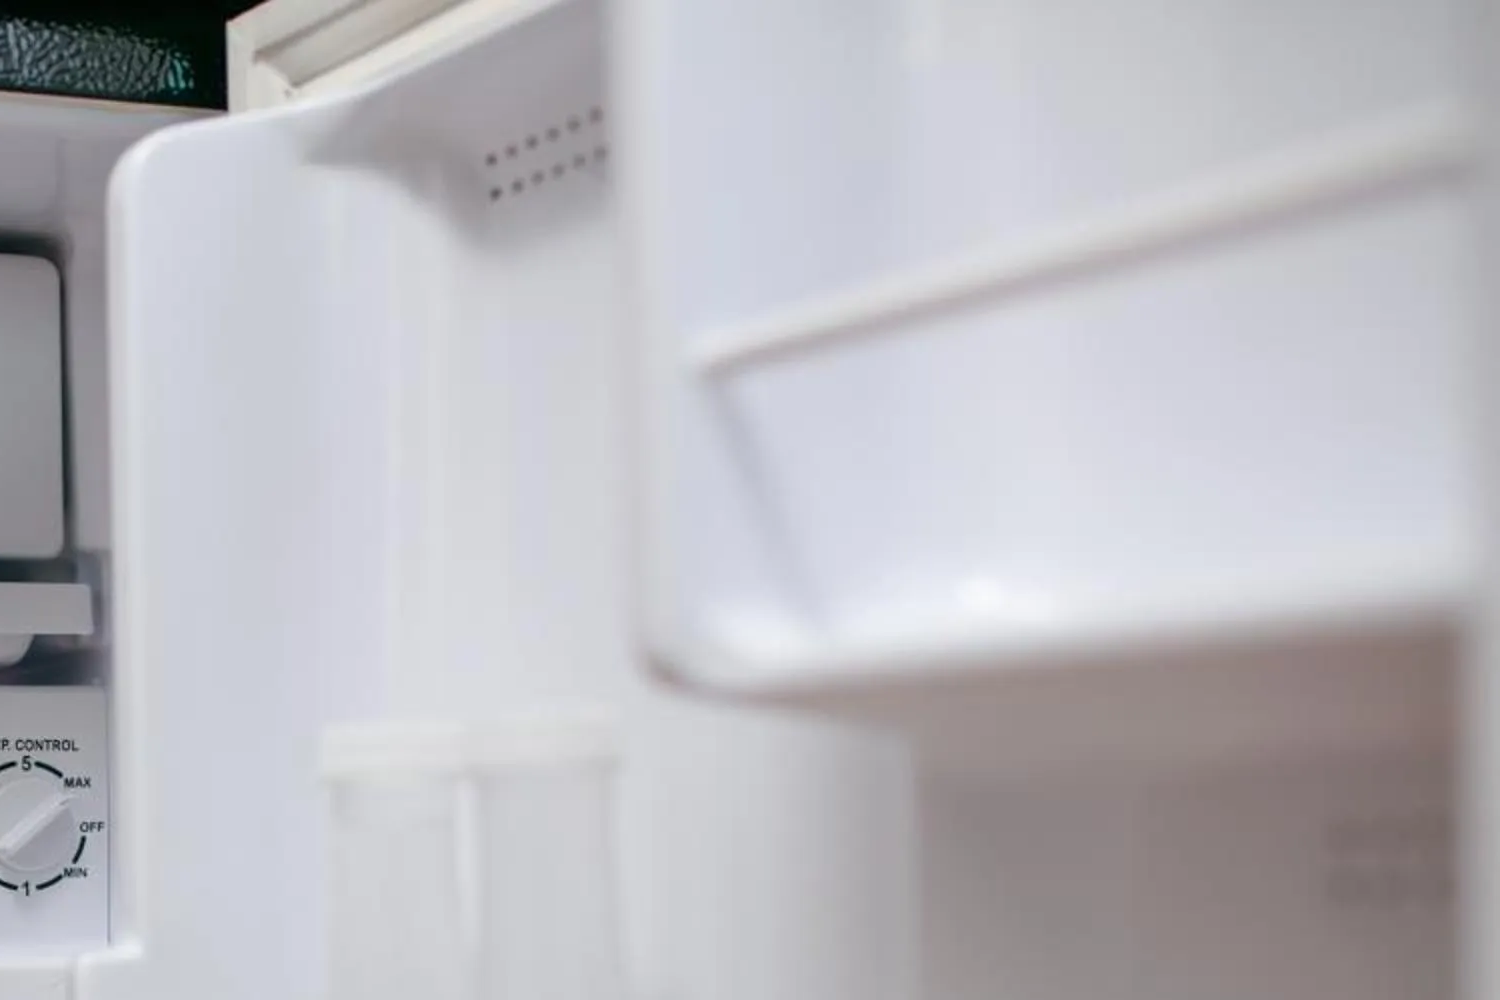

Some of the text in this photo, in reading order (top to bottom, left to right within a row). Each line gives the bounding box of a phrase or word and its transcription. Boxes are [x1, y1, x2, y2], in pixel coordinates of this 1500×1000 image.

[15, 739, 80, 751] CONTROL
[21, 755, 32, 771] 5
[63, 777, 91, 788] MAX
[79, 822, 105, 833] OFF
[63, 868, 87, 877] MIN
[21, 881, 30, 896] 1
